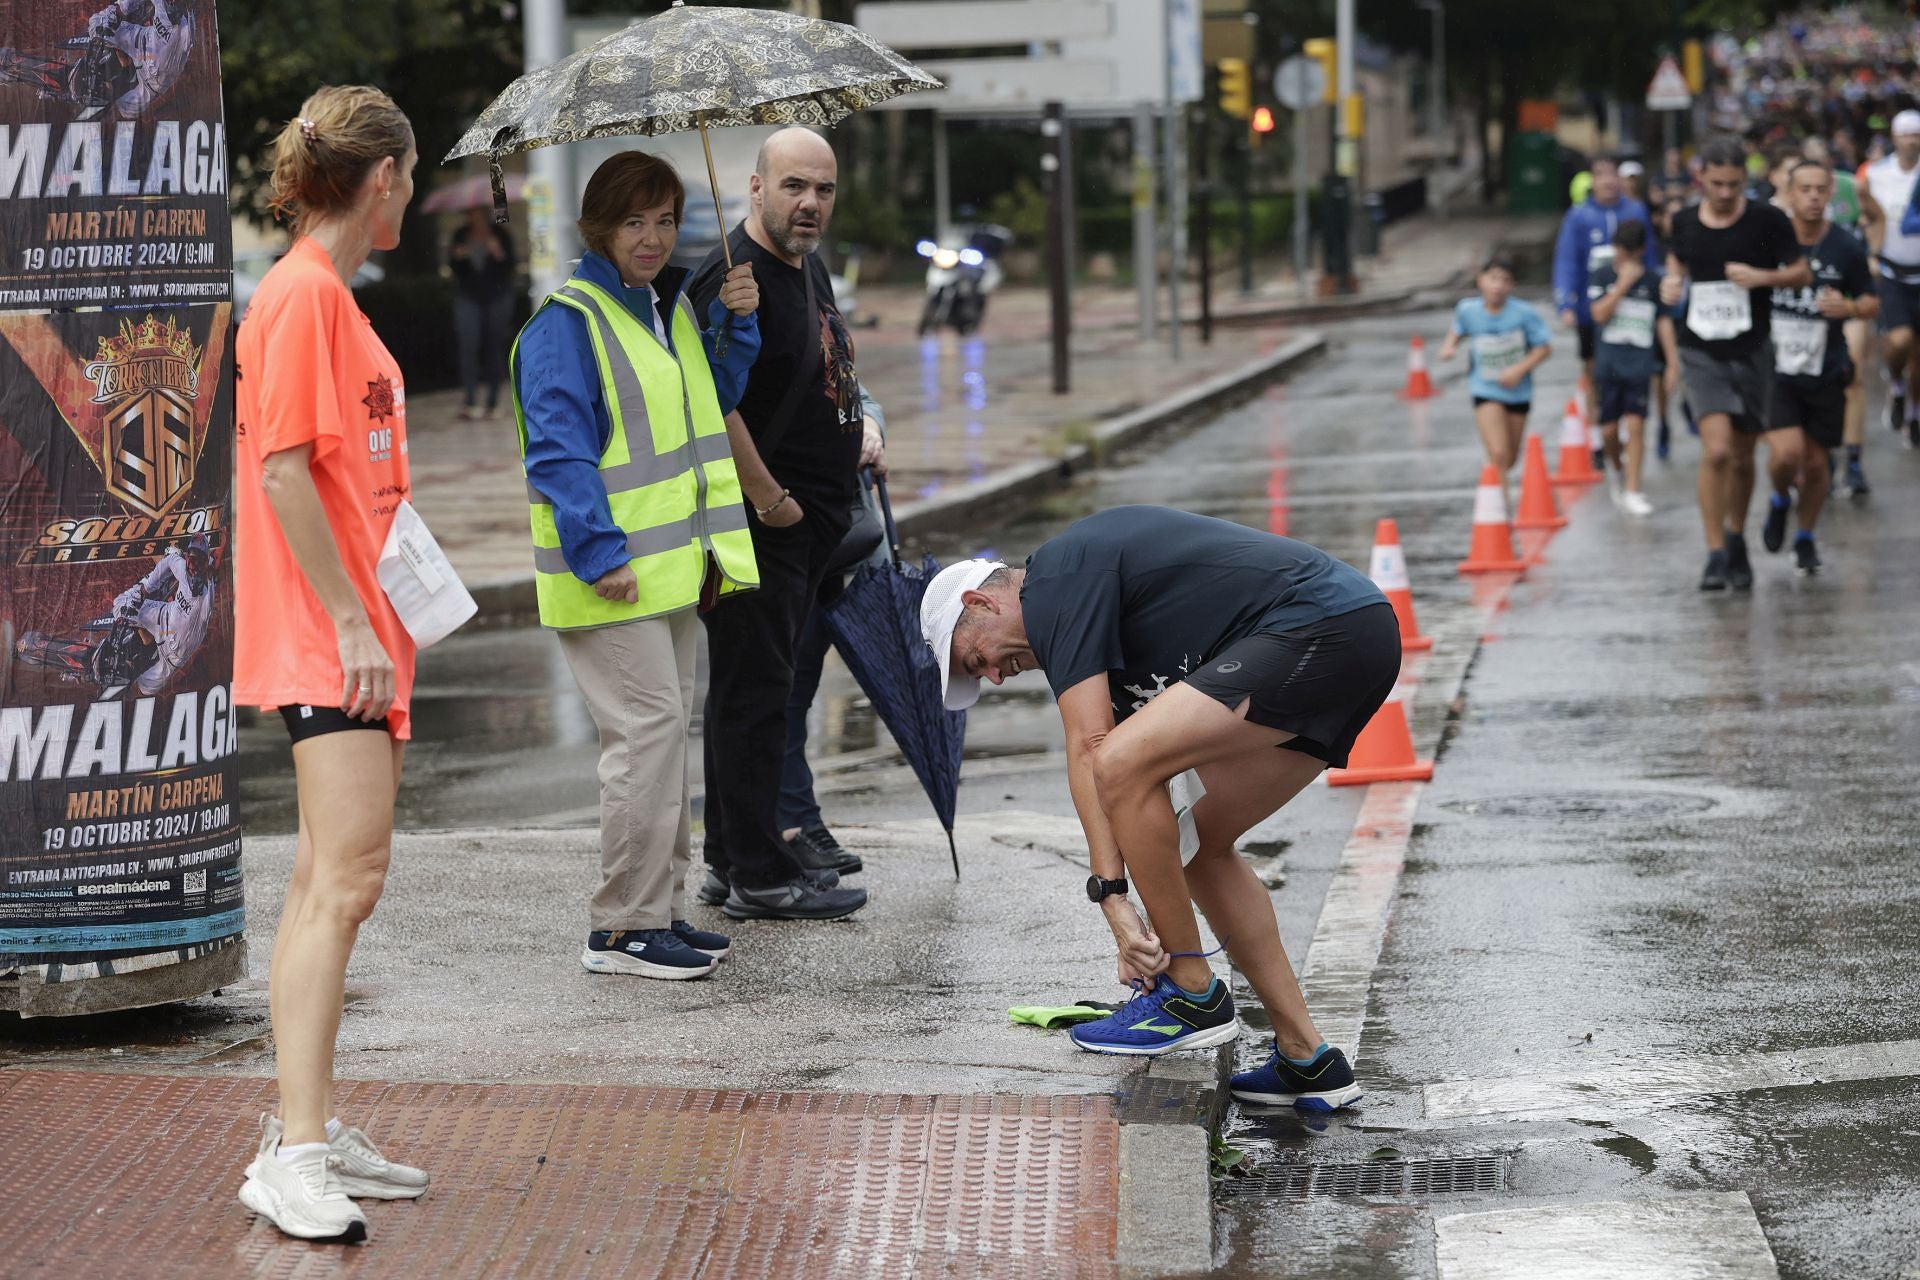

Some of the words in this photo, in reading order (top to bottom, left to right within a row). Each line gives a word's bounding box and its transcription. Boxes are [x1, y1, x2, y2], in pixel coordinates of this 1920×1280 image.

[46, 205, 137, 241] MARTÍN
[142, 208, 207, 237] CARPENA
[22, 247, 45, 270] 19
[50, 244, 133, 269] OCTUBRE
[42, 286, 108, 302] ANTICIPADA
[39, 517, 151, 546] SOLO
[0, 683, 238, 782] MÁLAGA
[66, 781, 154, 820] MARTÍN
[160, 773, 223, 812] CARPENA
[43, 827, 65, 850] 19
[70, 819, 151, 849] OCTUBRE
[153, 814, 189, 839] 2024
[200, 804, 230, 832] 19:00H
[8, 869, 60, 885] ENTRADA
[62, 861, 126, 881] ANTICIPADA
[20, 889, 74, 898] BENALMÁDENA
